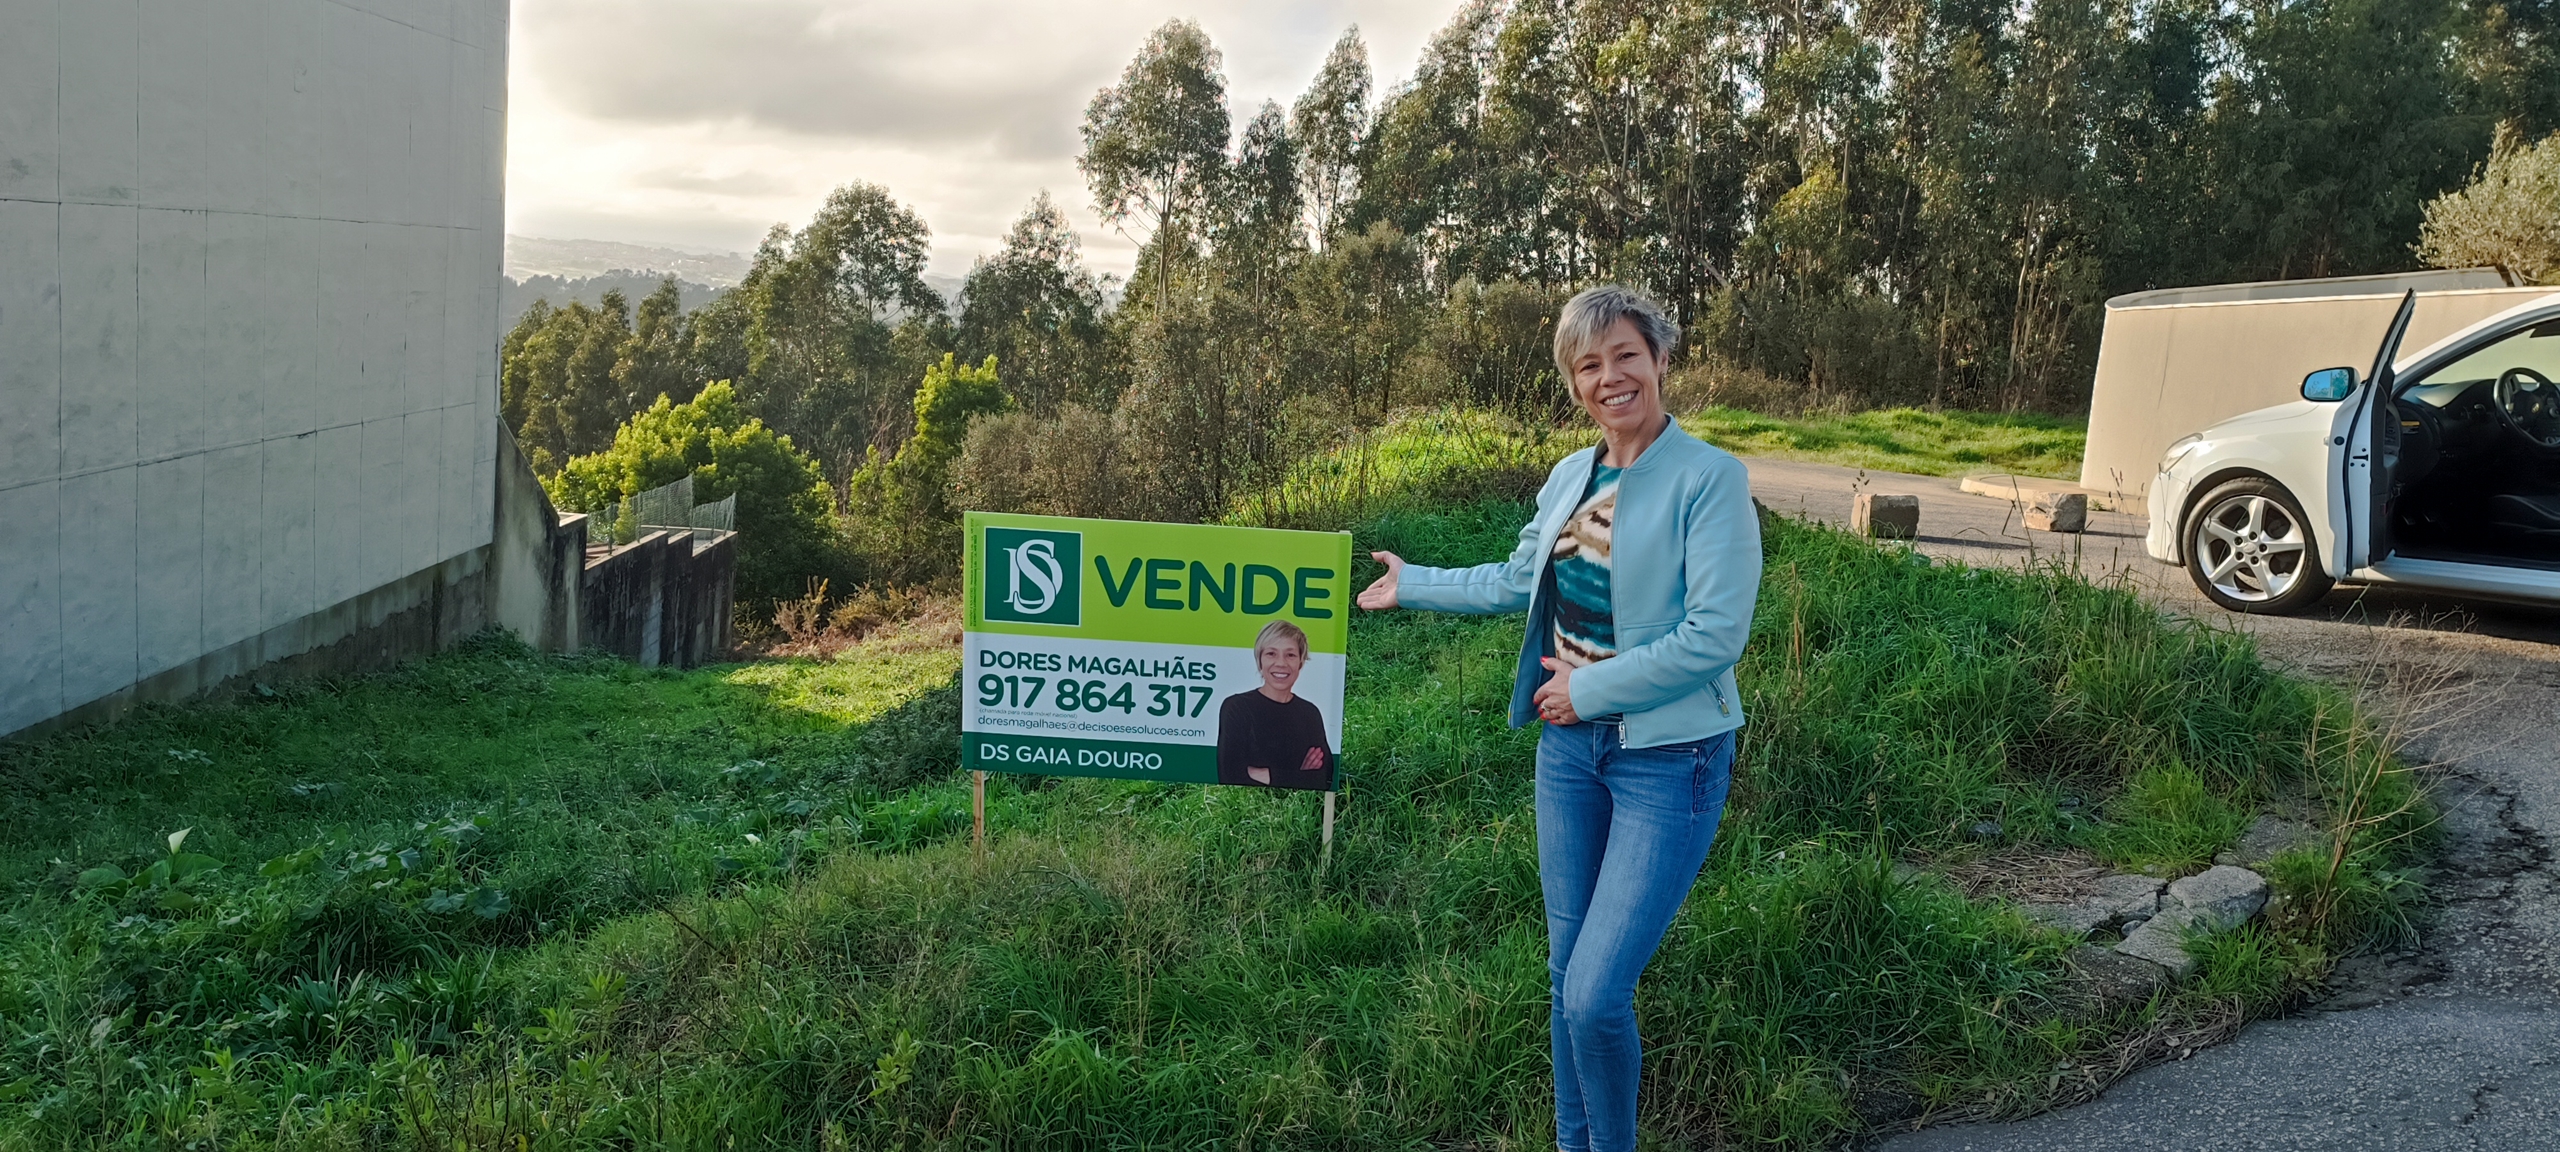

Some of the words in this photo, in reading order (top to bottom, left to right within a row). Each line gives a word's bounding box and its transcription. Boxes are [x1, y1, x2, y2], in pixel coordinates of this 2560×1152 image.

[1003, 539, 1063, 615] DS
[1094, 554, 1335, 619] VENDE
[980, 649, 1062, 672] DORES
[1068, 655, 1217, 681] MAGALHÃES
[978, 673, 1046, 709] 917
[1055, 678, 1137, 715] 864
[1146, 683, 1214, 719] 317
[977, 715, 1206, 738] doresmagalhaes@decisoesesolucoes.com
[980, 743, 1010, 761] DS
[1015, 745, 1072, 765] GAIA
[1078, 749, 1163, 770] DOURO
